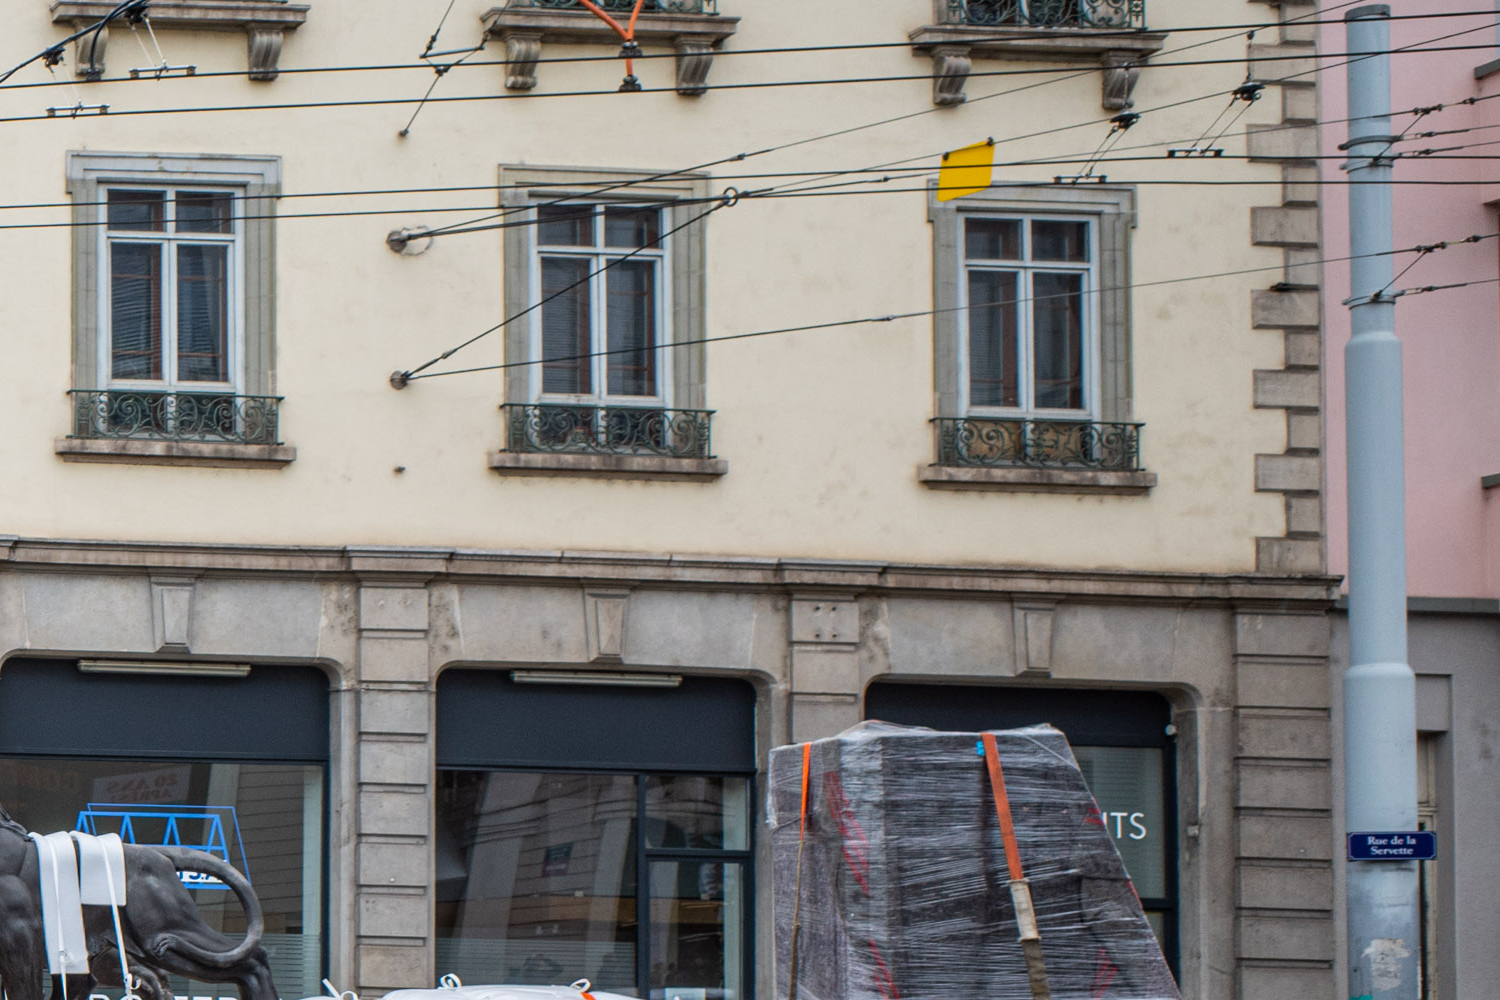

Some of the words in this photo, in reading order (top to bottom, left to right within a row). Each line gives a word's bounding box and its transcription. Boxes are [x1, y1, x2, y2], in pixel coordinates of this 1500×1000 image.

[1101, 812, 1147, 839] TS
[1367, 835, 1388, 845] Rue
[1390, 835, 1404, 845] de
[1406, 835, 1417, 845] la
[1370, 845, 1414, 855] Servette
